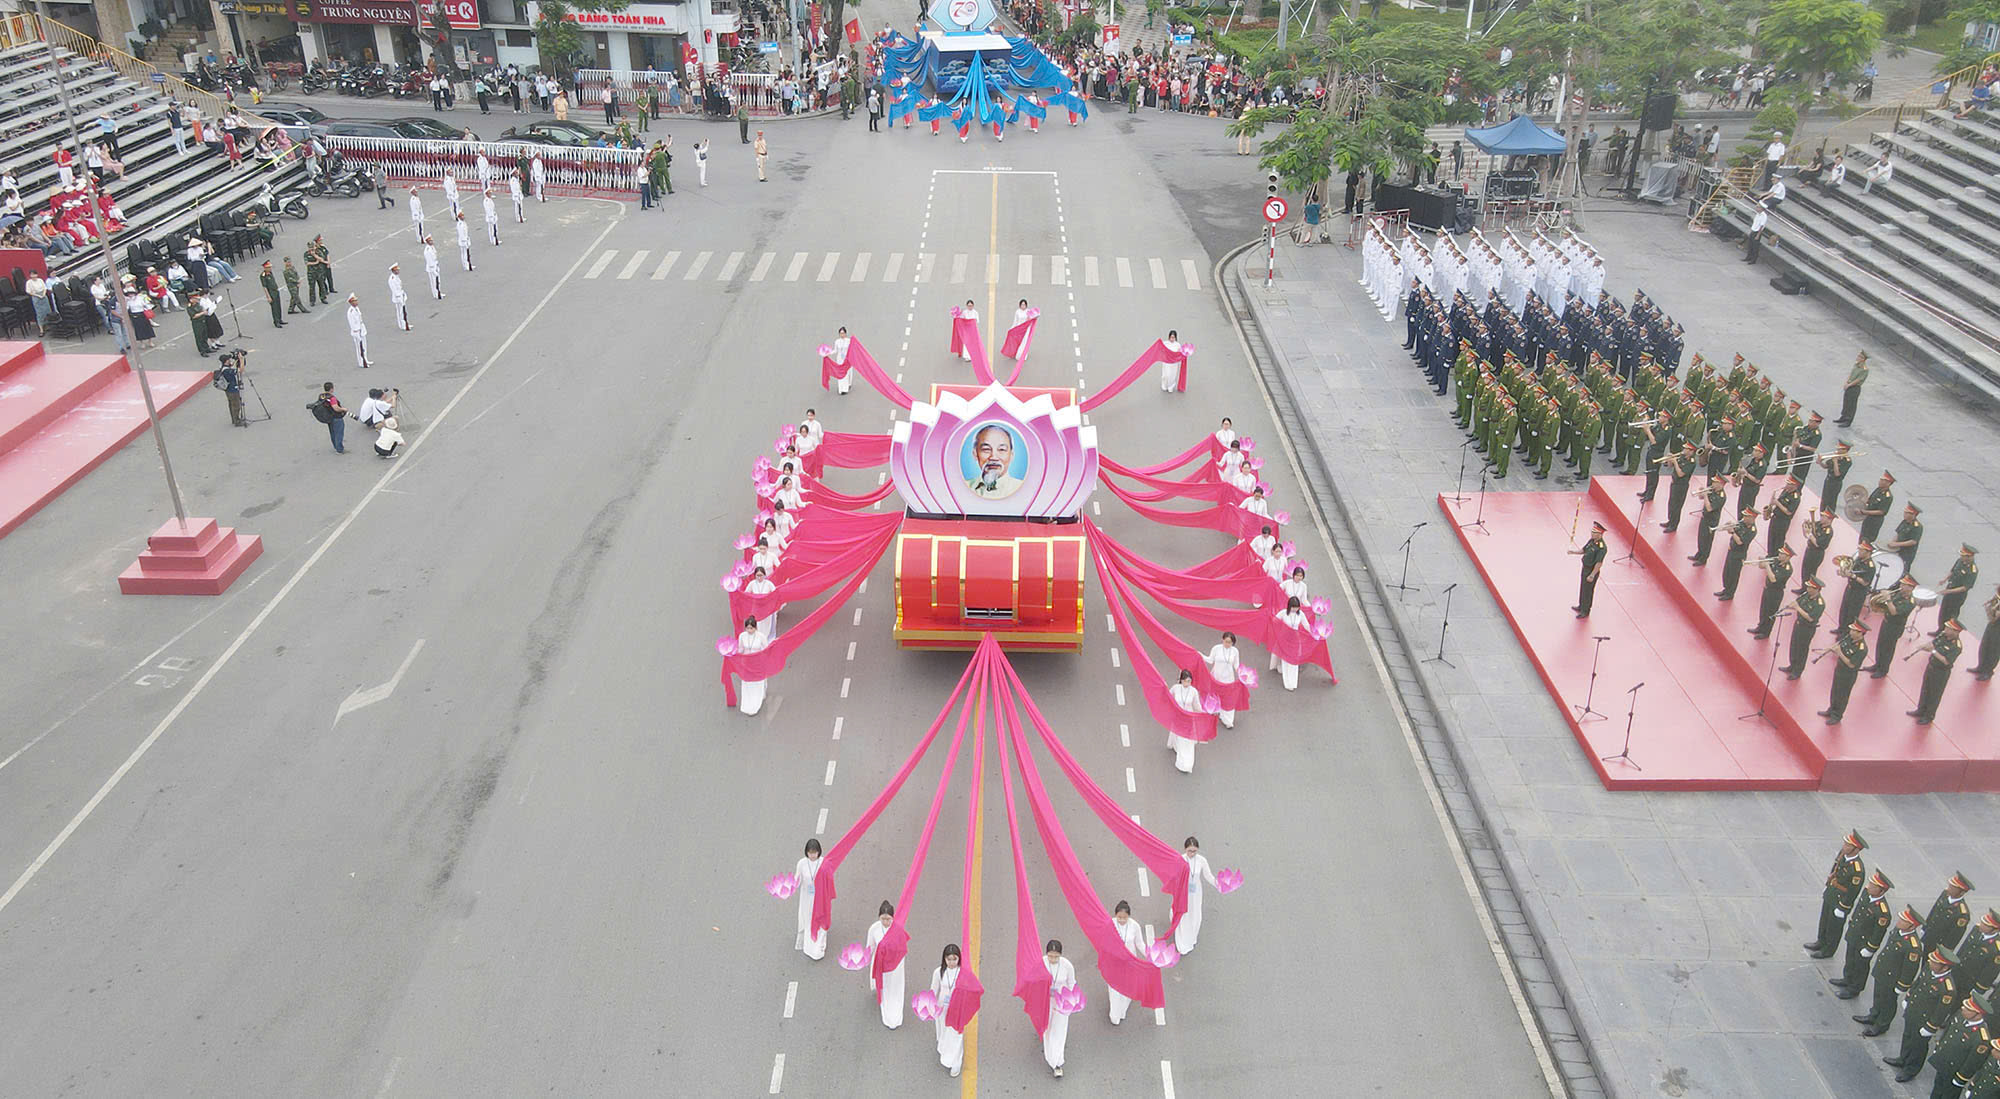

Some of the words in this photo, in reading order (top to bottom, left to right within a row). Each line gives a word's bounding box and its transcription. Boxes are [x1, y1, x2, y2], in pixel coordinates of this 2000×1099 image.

[320, 7, 360, 18] TRUNG
[362, 7, 412, 20] NGUYÊN
[421, 4, 457, 16] CIRLE
[643, 16, 666, 25] NHA
